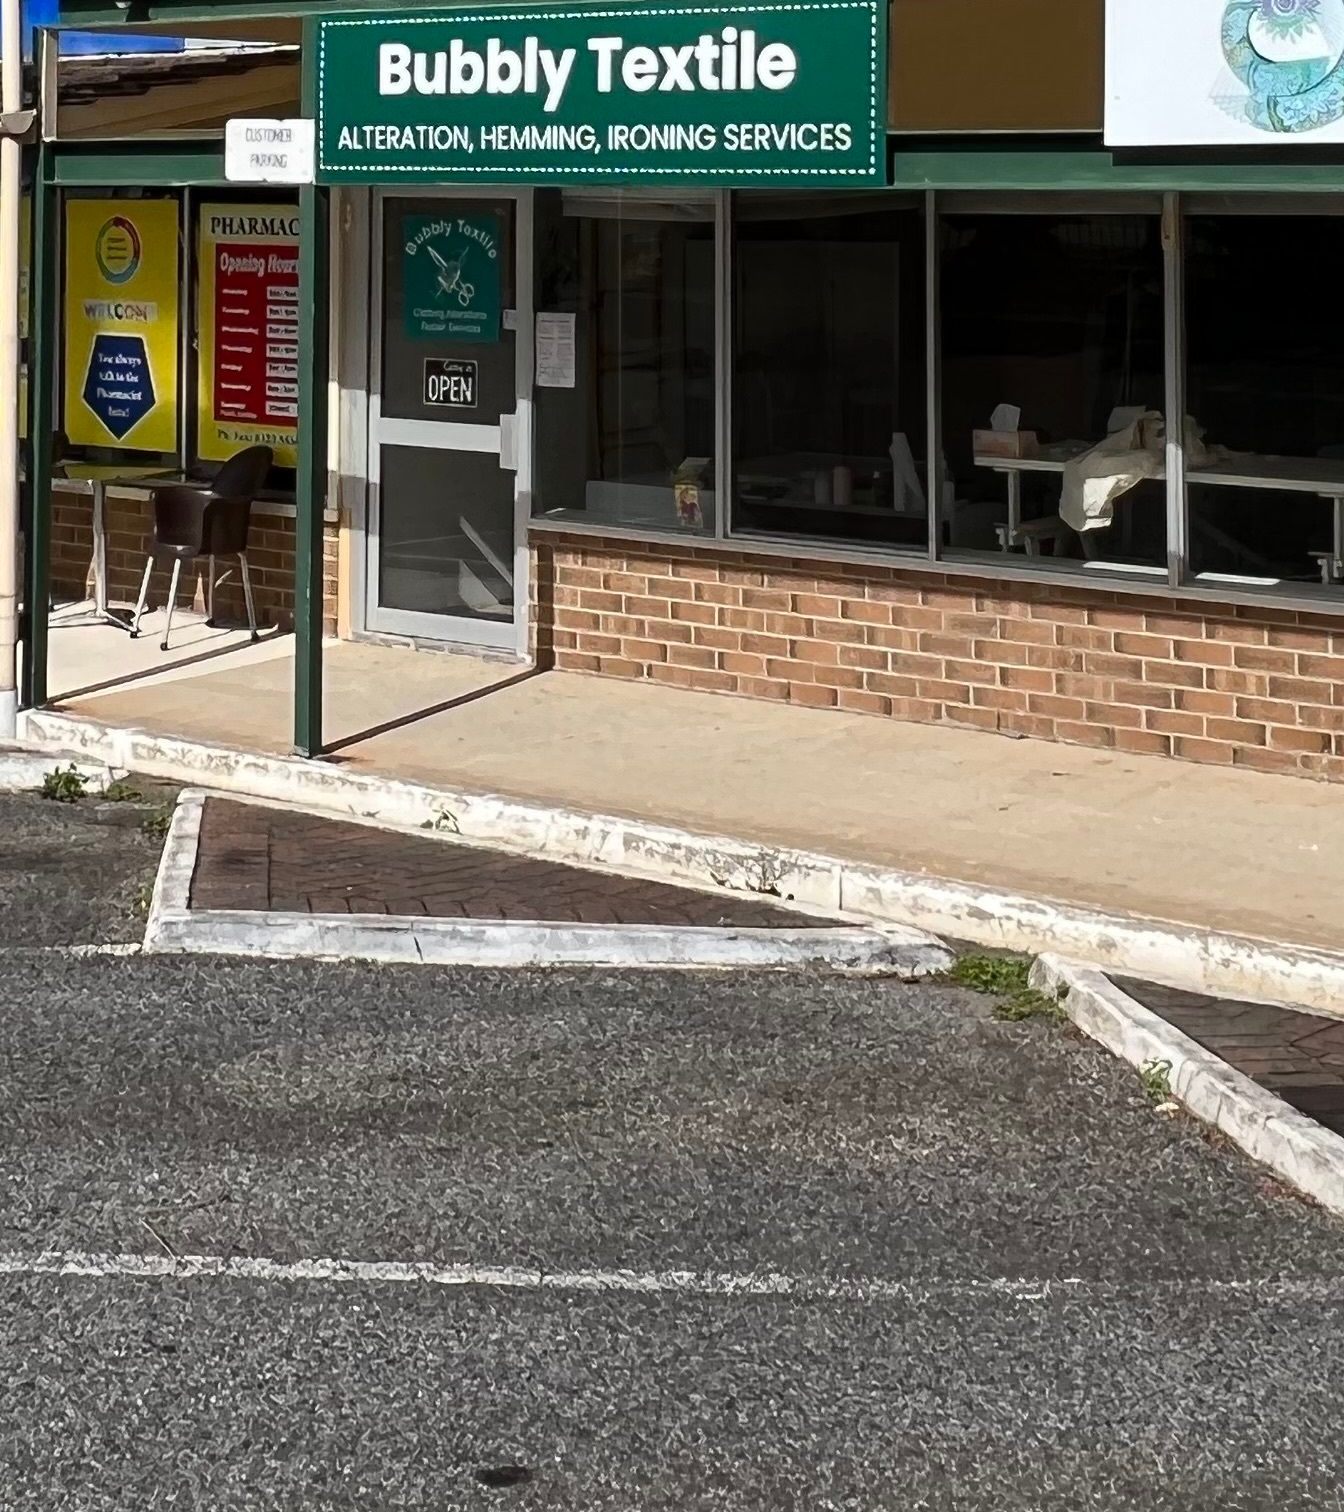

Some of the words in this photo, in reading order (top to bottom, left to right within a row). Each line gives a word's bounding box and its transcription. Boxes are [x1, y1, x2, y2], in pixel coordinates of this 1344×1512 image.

[379, 35, 576, 112] Bubbly
[587, 26, 797, 93] Textile
[338, 125, 475, 155] ALTERATION,
[480, 124, 602, 154] HEMMING,
[607, 123, 718, 152] IRONING
[722, 123, 852, 152] SERVICES
[210, 217, 299, 236] PHARMAC
[405, 219, 453, 256] Bubbly
[428, 374, 473, 403] OPEN
